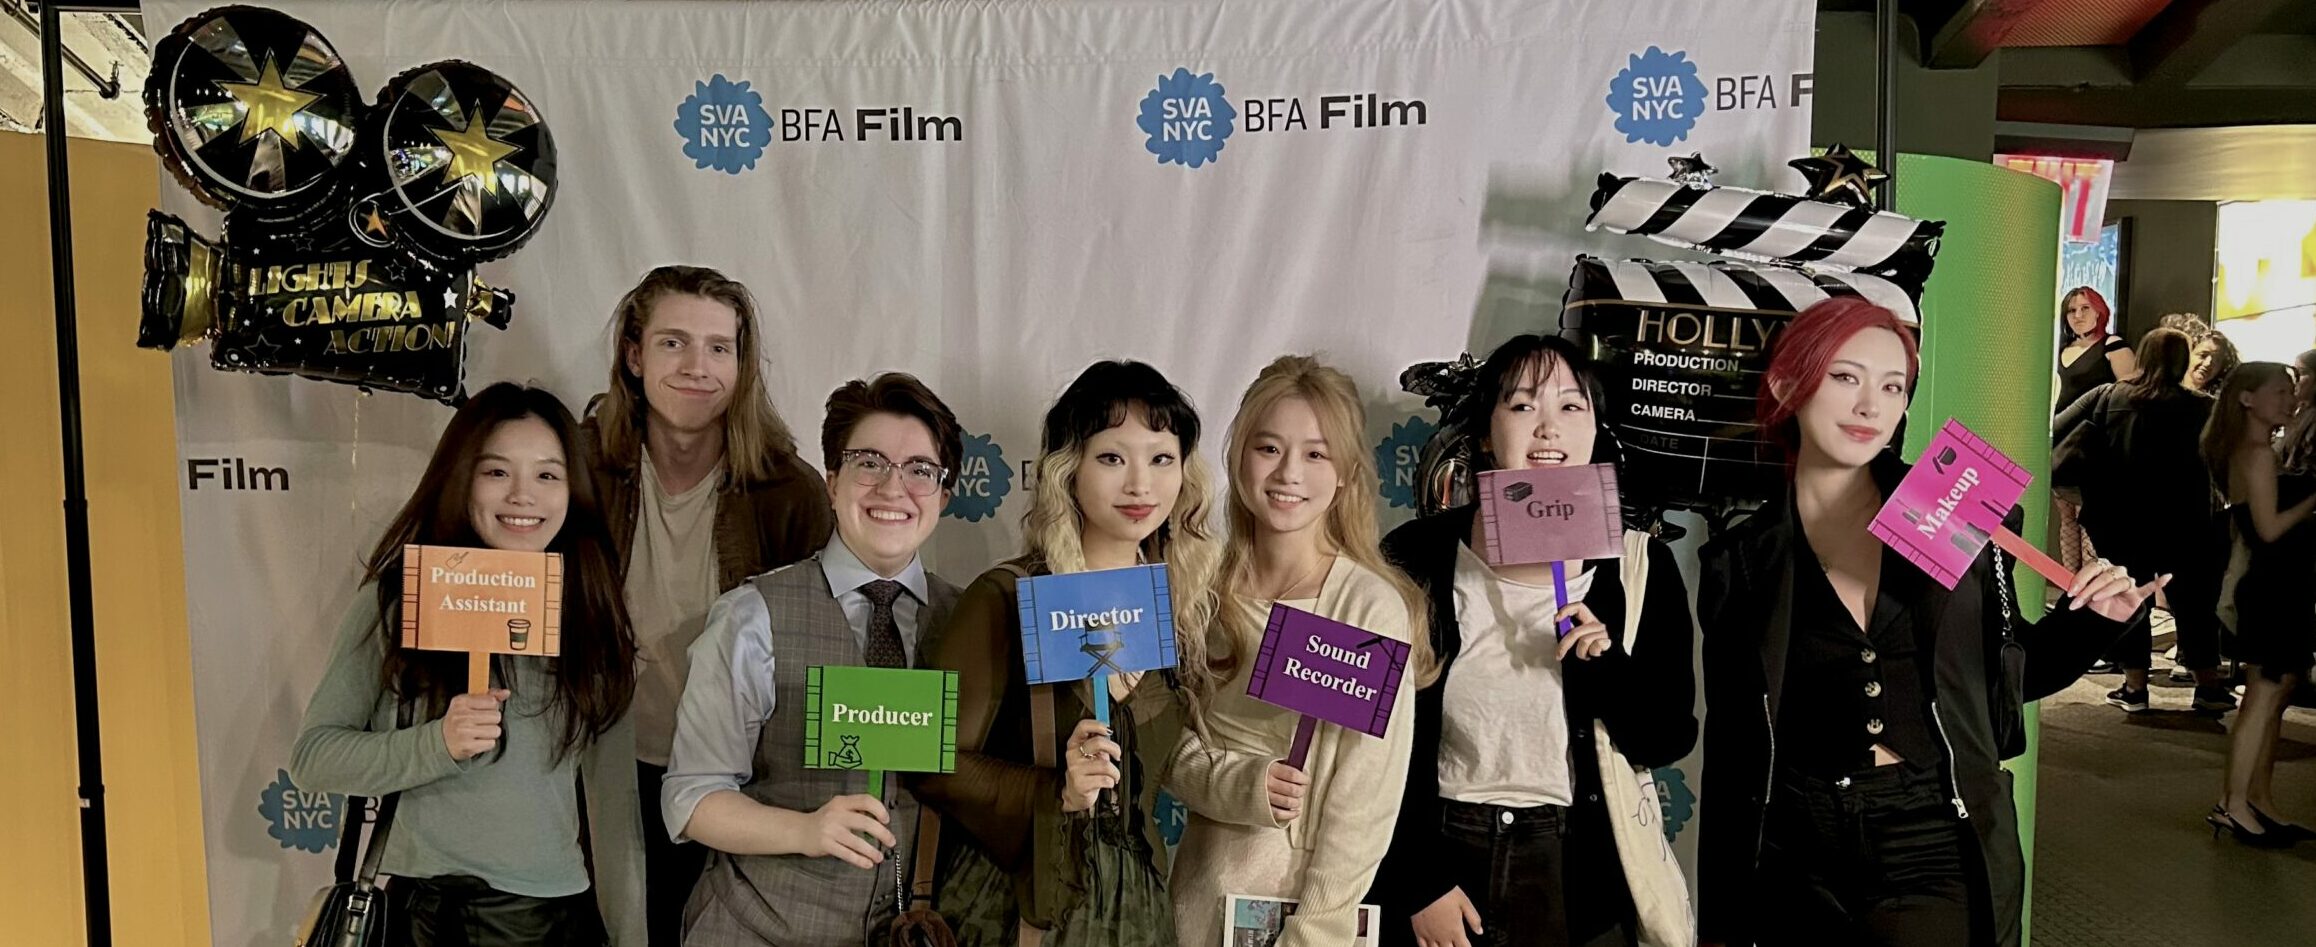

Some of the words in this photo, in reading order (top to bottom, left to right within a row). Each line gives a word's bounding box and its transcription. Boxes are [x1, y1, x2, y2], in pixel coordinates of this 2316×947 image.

[1632, 75, 1683, 98] SVA
[1716, 75, 1777, 111] BFA
[700, 104, 750, 125] SVA
[1162, 97, 1212, 120] SVA
[1244, 98, 1308, 132] BFA
[1320, 93, 1427, 129] Film
[1632, 98, 1684, 121] NYC
[781, 108, 844, 142] BFA
[856, 106, 962, 142] Film
[1163, 120, 1213, 142] NYC
[700, 127, 751, 148] NYC
[249, 259, 372, 296] LIGHTS
[283, 291, 422, 328] CAMERA
[323, 321, 456, 355] ACTION!
[1637, 310, 1790, 351] HOLLY
[1633, 352, 1739, 372] PRODUCTION
[1632, 378, 1712, 397] DIRECTOR
[1631, 403, 1696, 421] CAMERA
[1640, 433, 1680, 450] DATE
[188, 457, 289, 491] Film
[960, 456, 990, 475] VA
[1526, 499, 1575, 521] Grip
[1916, 466, 1981, 540] Makeup
[431, 566, 536, 589] Production
[439, 593, 528, 614] Assistant
[1049, 606, 1144, 632] Director
[1305, 634, 1371, 670] Sound
[1282, 657, 1378, 702] Recorder
[832, 703, 933, 726] Producer
[282, 789, 332, 810] SVA
[283, 810, 333, 830] NYC
